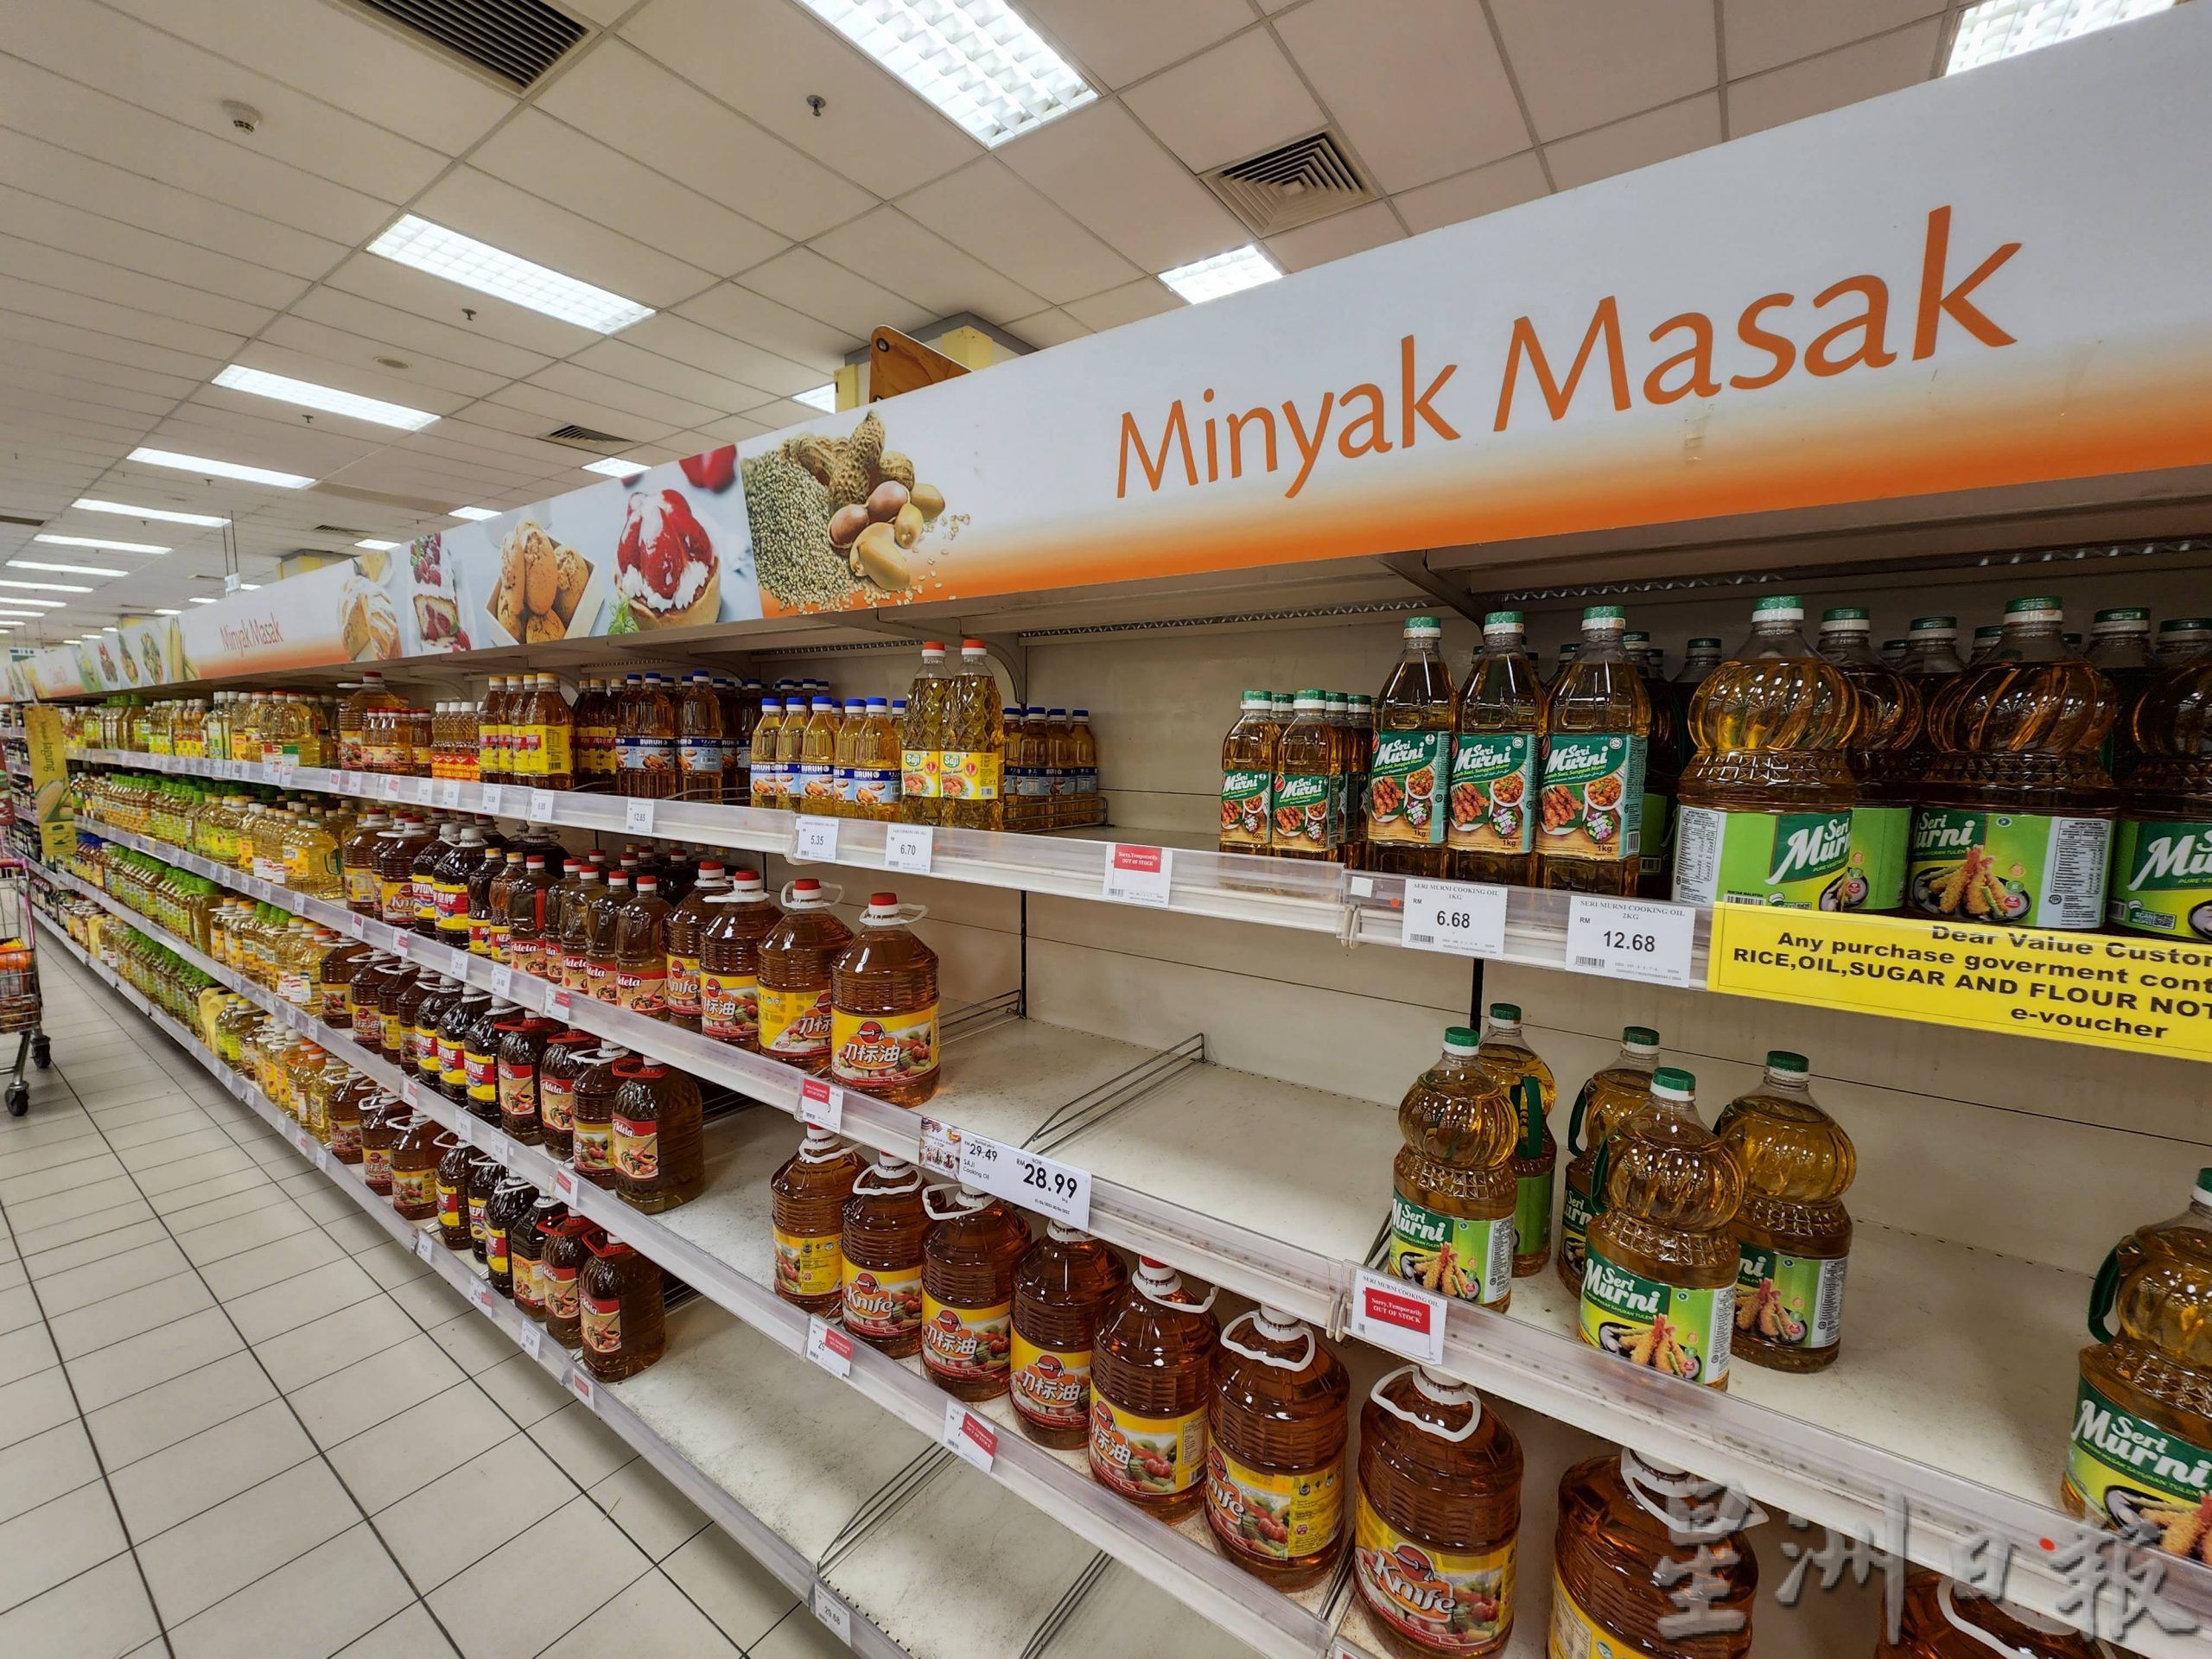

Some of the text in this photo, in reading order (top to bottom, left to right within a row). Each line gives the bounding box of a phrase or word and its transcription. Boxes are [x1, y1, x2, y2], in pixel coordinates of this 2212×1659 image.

[1116, 205, 2022, 499] Minyak Masak
[219, 612, 283, 657] Minyak Masak
[1375, 742, 1425, 767] Murni
[1393, 740, 1410, 752] Seri
[1472, 744, 1494, 758] Seri
[1566, 745, 1590, 758] Seri
[906, 754, 921, 765] Saji
[944, 755, 960, 766] Saji
[1453, 746, 1511, 772] Murni
[1545, 746, 1608, 774] Murni
[1223, 774, 1257, 792] Murni
[1281, 780, 1322, 798] Murni
[1916, 820, 1975, 847] urni
[1920, 812, 1947, 830] Seri
[810, 836, 824, 845] 5.35
[900, 844, 916, 855] 6.70
[1453, 887, 1486, 895] COOKING
[1436, 910, 1471, 928] 6.68
[1628, 905, 1668, 914] COOKING
[1604, 931, 1656, 952] 12.68
[1932, 925, 1995, 944] Dear
[2007, 933, 2094, 955] Value
[1777, 931, 1823, 952] Any
[1832, 940, 1955, 964] purchase
[1965, 954, 2129, 984] goverment
[1733, 948, 2212, 1020] RICE,OIL,SUGAR AND FLOUR NOT
[2011, 1007, 2169, 1039] e-voucher
[846, 1043, 900, 1064] 刀标油
[969, 1143, 998, 1162] 29.49
[963, 1166, 982, 1179] Cooking
[1016, 1158, 1077, 1199] RM 28.99
[1567, 1190, 1585, 1210] Seri
[1391, 1198, 1446, 1242] Murni
[1402, 1204, 1426, 1224] Seri
[1363, 1276, 1376, 1285] SERI
[1377, 1281, 1397, 1292] MURNI
[1398, 1287, 1427, 1303] COOKING
[1581, 1257, 1661, 1314] Murni
[1603, 1267, 1636, 1292] Seri
[848, 1285, 894, 1314] Knife
[1373, 1305, 1387, 1313] OUT
[1398, 1312, 1421, 1324] STOCK
[926, 1325, 977, 1355] 刀标油
[1022, 1370, 1080, 1401] 刀标油
[2070, 1400, 2212, 1488] Murni
[2111, 1416, 2168, 1454] Seri
[1210, 1477, 1245, 1518] nife
[1374, 1554, 1456, 1615] Knife
